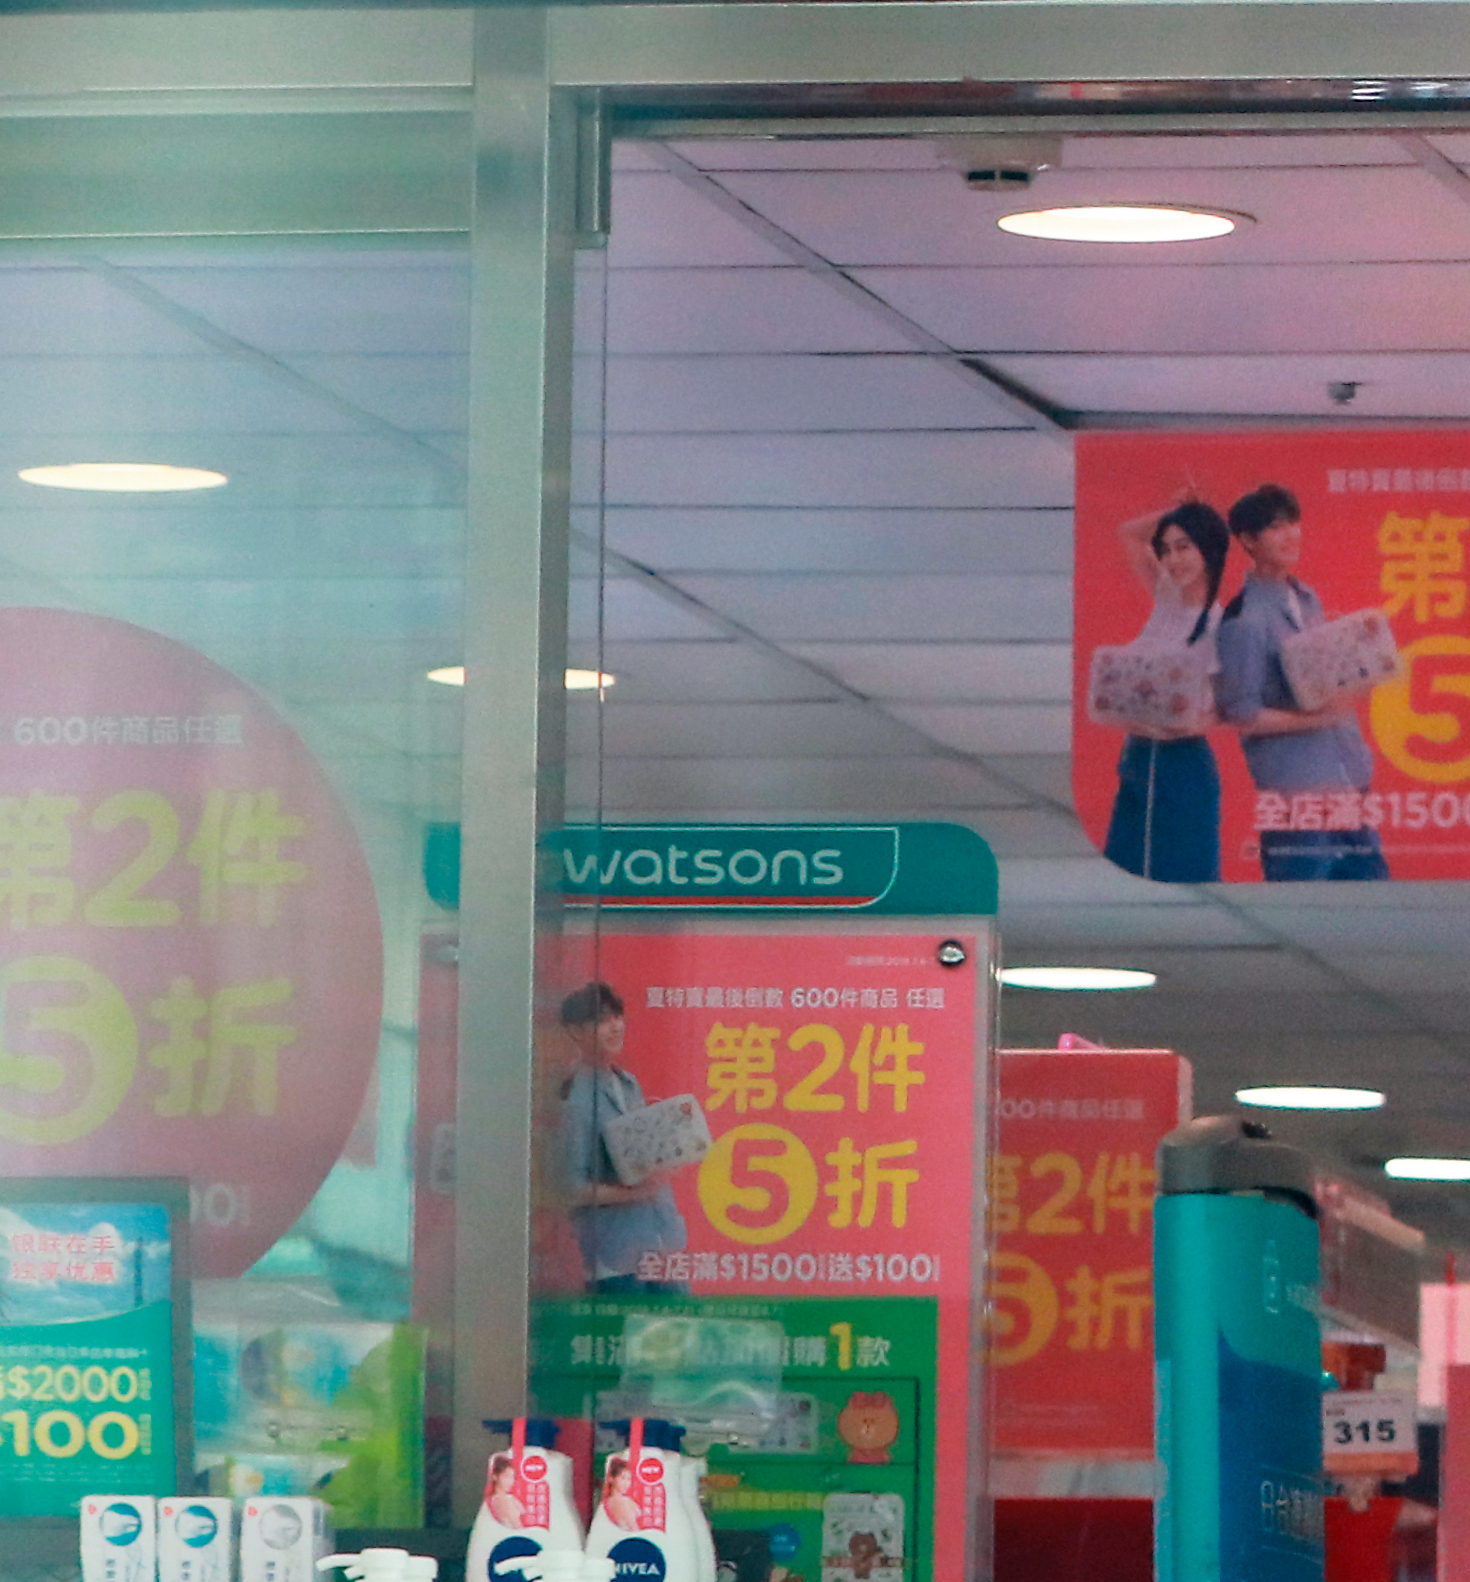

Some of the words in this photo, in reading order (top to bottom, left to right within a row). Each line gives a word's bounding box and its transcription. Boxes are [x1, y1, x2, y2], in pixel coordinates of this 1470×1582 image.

[0, 787, 309, 928] 第2件
[562, 844, 844, 886] watsons
[790, 986, 898, 1008] 600件商品
[705, 1022, 926, 1113] 第2件
[697, 1123, 920, 1244] 5折
[1333, 1419, 1397, 1445] 315
